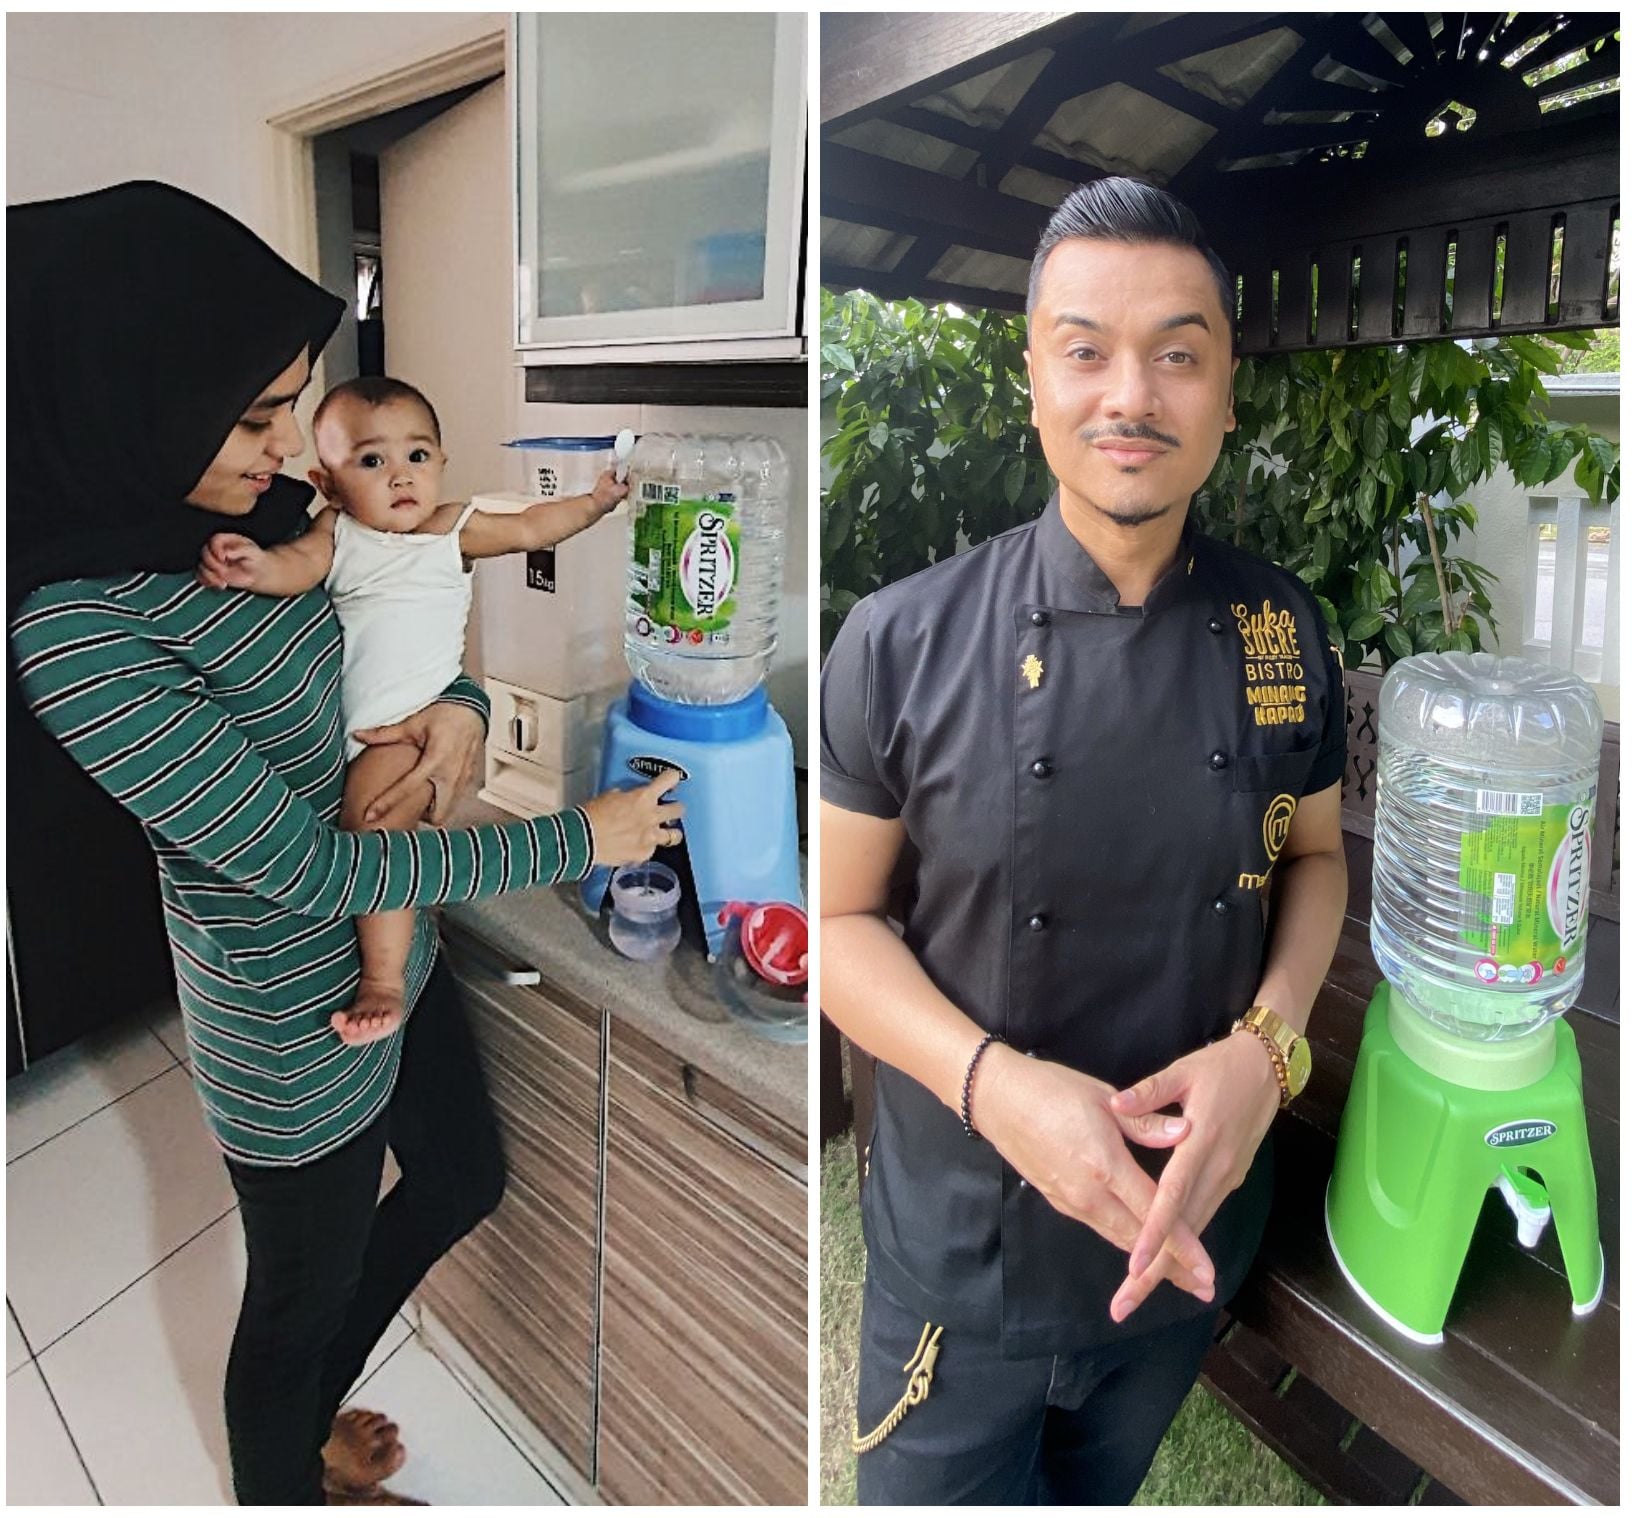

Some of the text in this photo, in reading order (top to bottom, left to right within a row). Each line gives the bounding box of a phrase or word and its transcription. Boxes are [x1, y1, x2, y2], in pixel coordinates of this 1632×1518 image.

[697, 513, 725, 616] SPRITZER
[1231, 599, 1295, 634] Suka
[1241, 627, 1301, 656] SUCRE
[1245, 662, 1304, 682] BISTRO
[1246, 685, 1307, 705] MINANG
[1563, 807, 1590, 946] SPRITZER
[1489, 1125, 1552, 1146] SPRITZER
